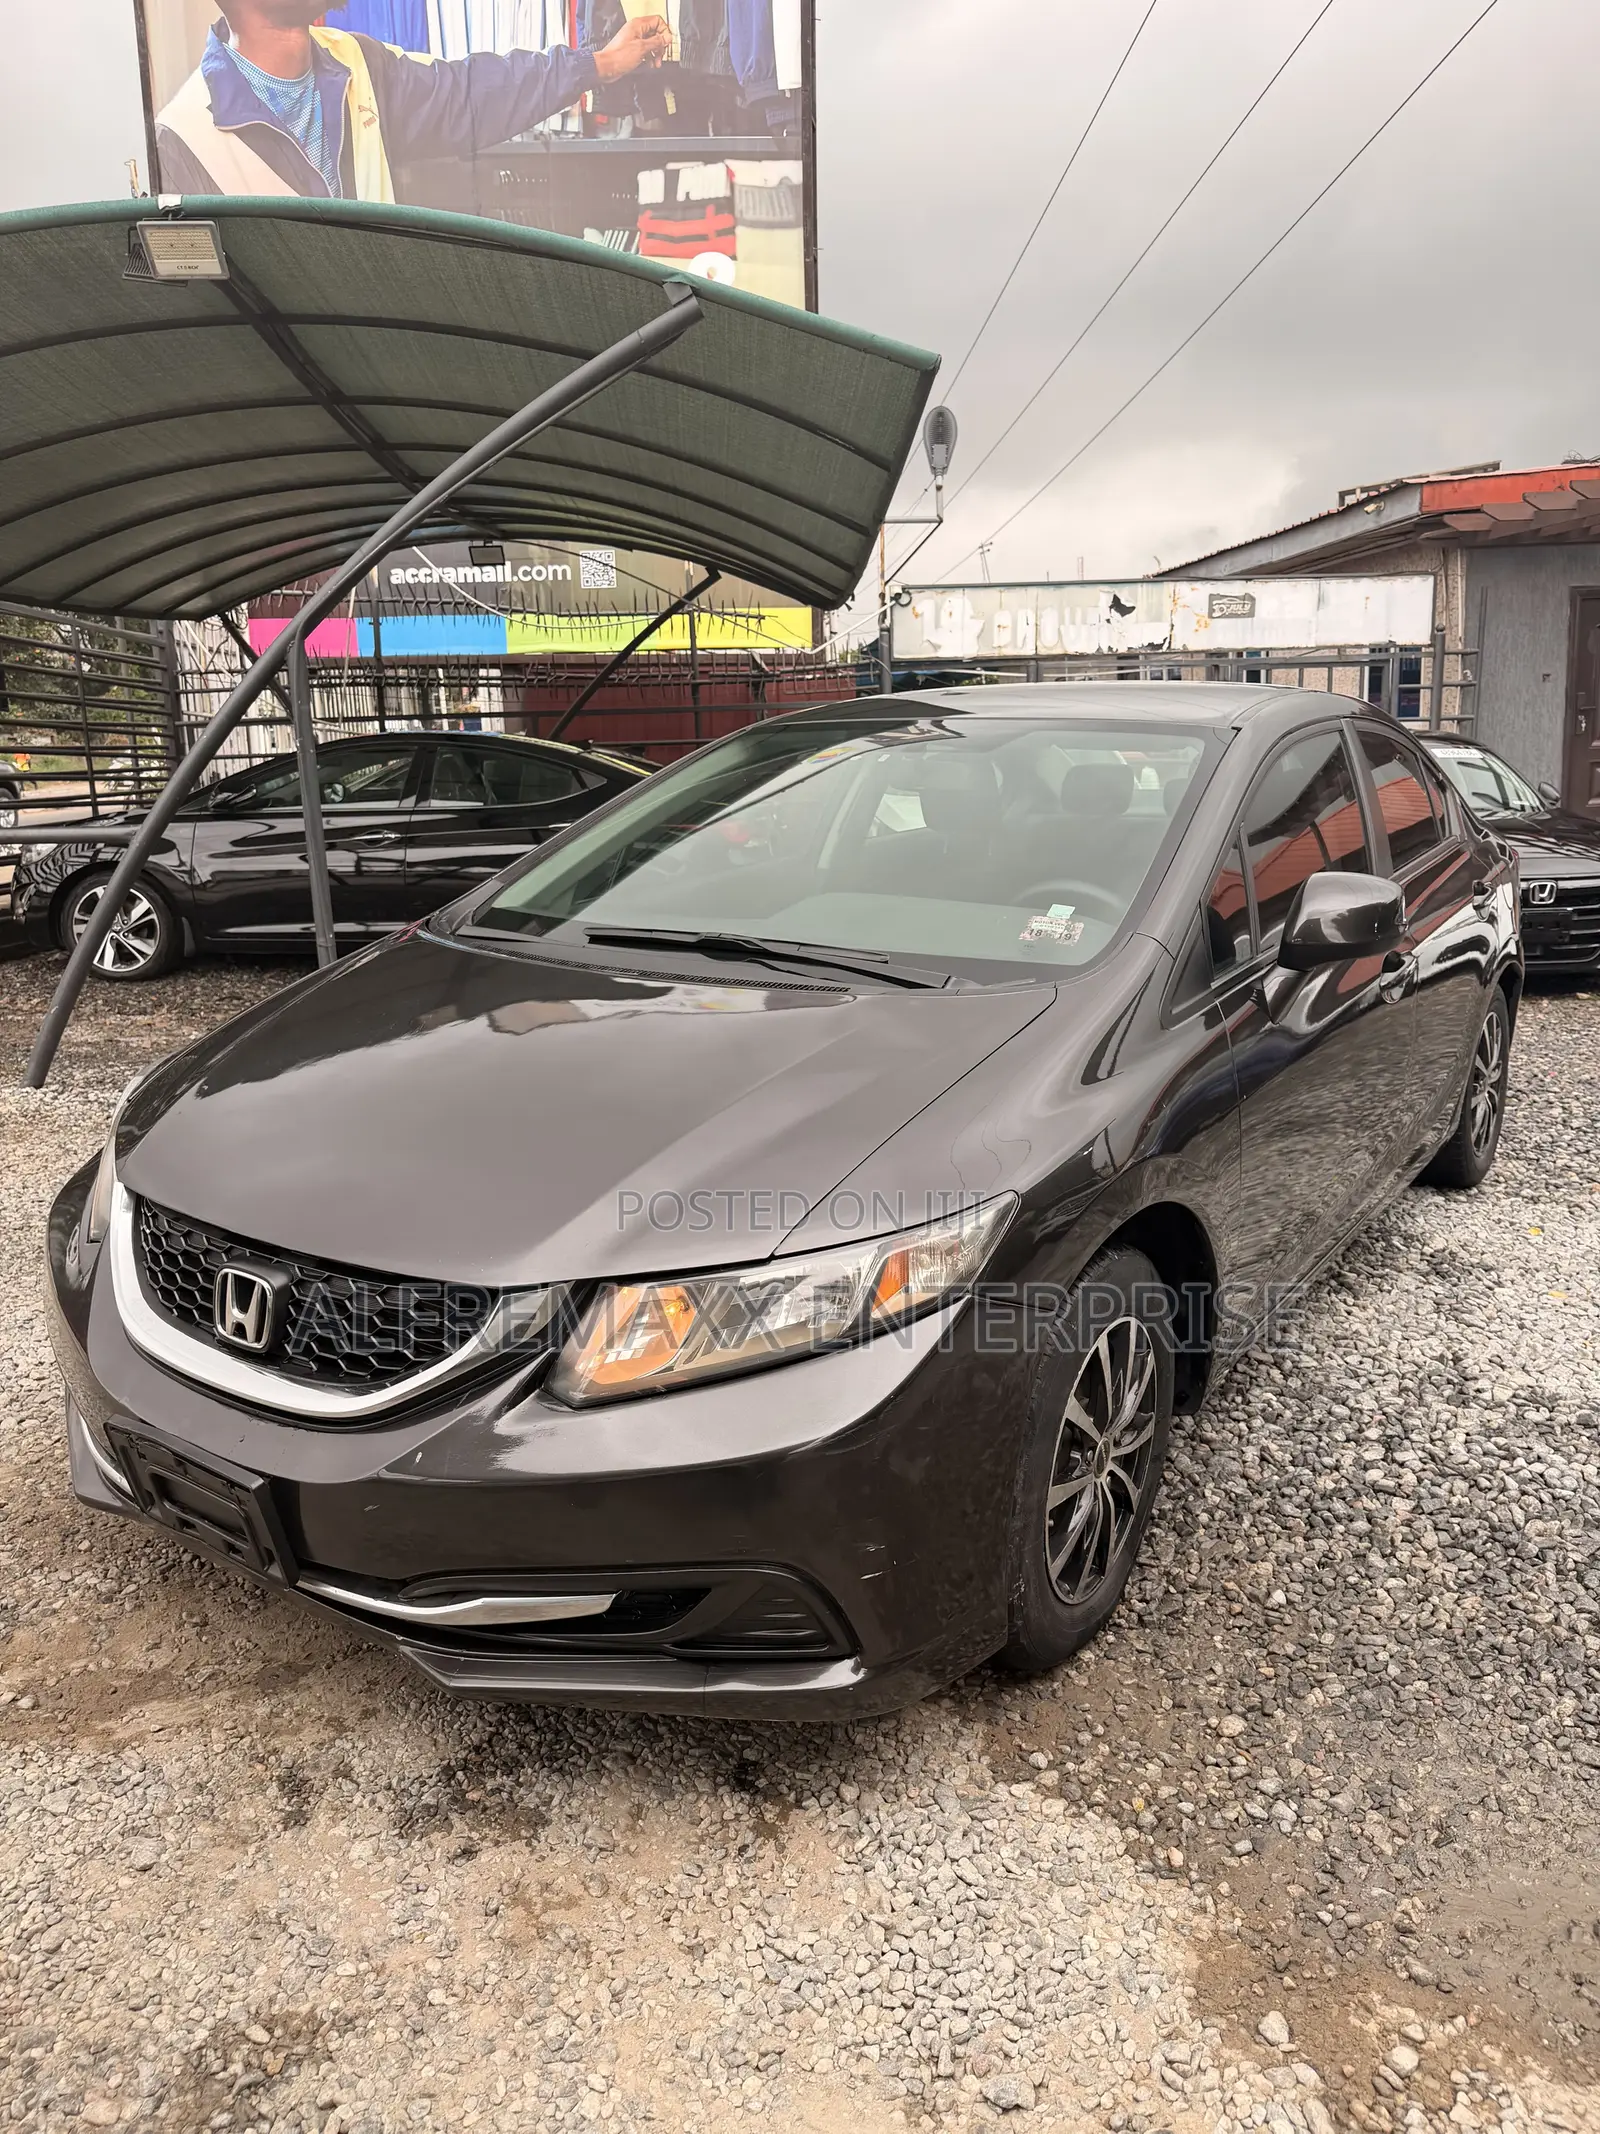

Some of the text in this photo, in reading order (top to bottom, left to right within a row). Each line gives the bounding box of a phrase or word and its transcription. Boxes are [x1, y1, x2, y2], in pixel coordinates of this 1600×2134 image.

[390, 560, 572, 585] accramall.com
[1029, 928, 1073, 941] 18 19
